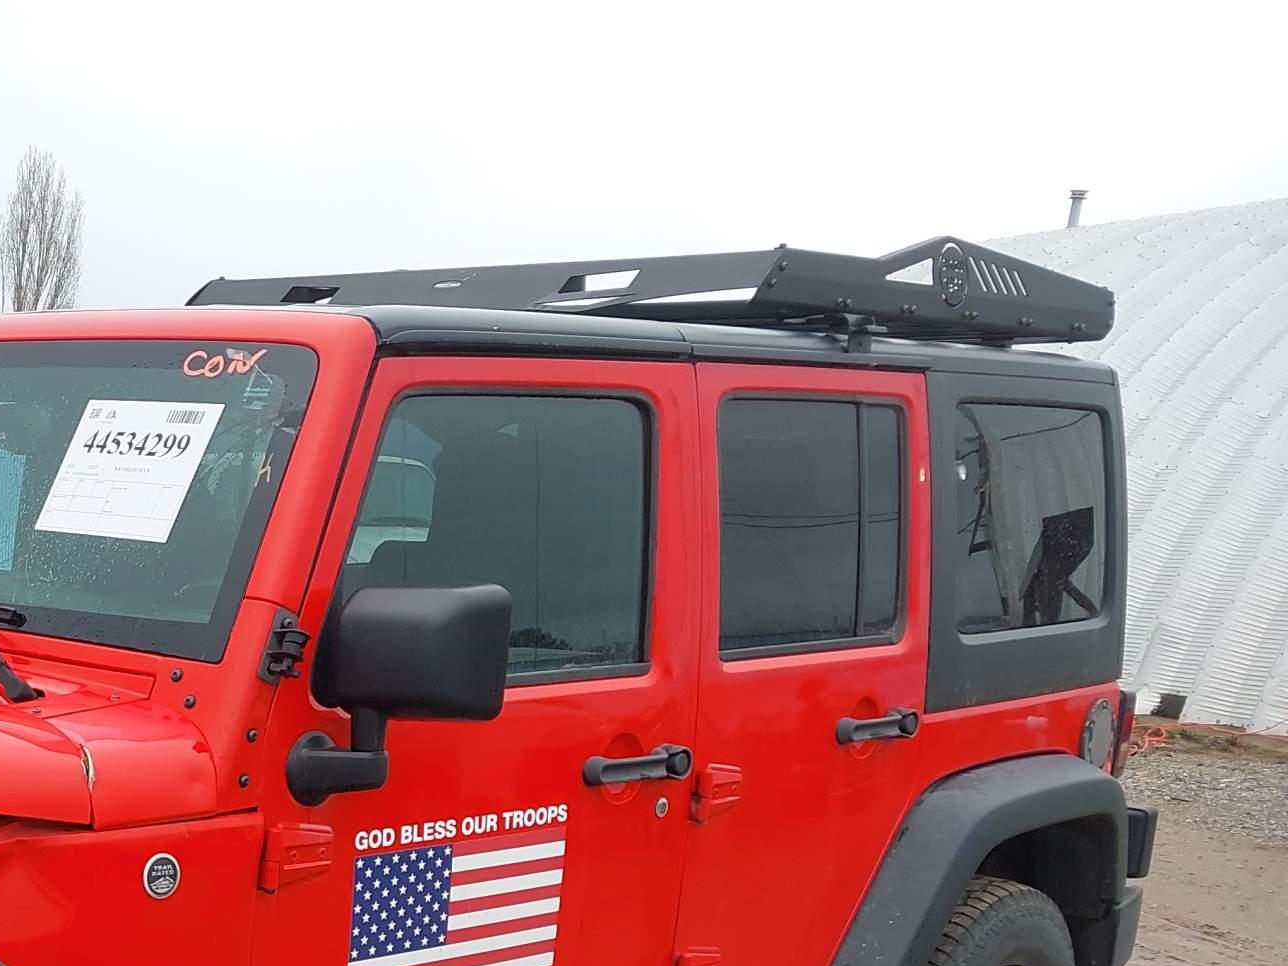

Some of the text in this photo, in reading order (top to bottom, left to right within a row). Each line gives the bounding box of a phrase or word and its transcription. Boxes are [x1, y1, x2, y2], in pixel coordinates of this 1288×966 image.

[83, 430, 191, 458] 44534299
[355, 804, 568, 850] GOD BLESS OUR TROOPS
[152, 869, 175, 877] RATED
